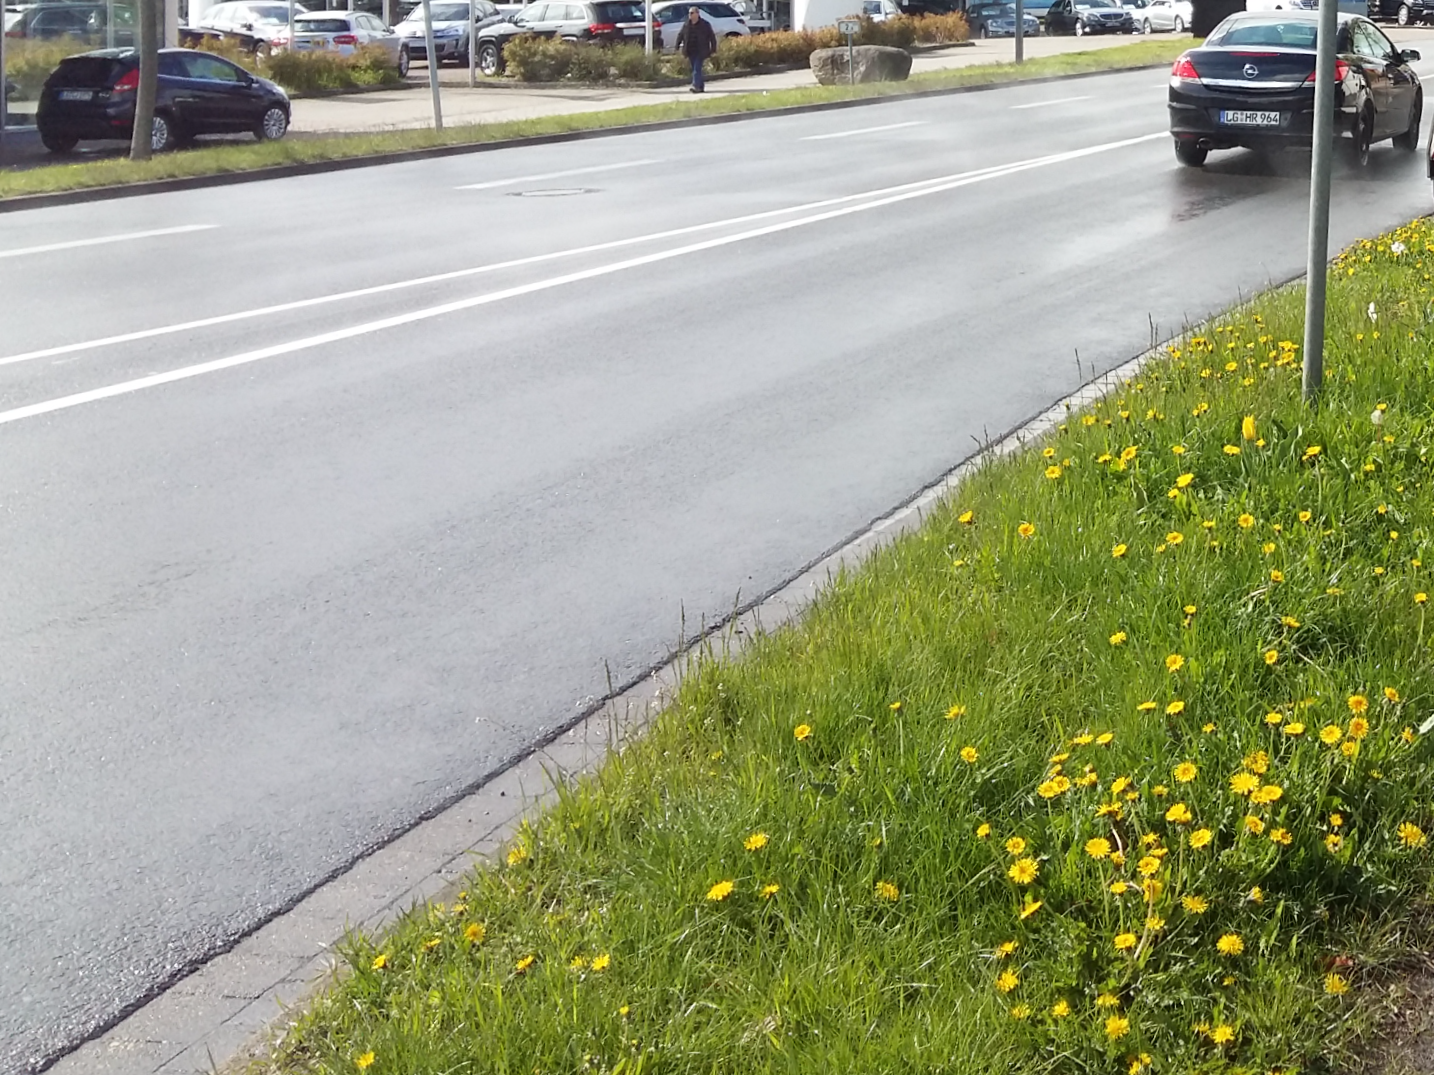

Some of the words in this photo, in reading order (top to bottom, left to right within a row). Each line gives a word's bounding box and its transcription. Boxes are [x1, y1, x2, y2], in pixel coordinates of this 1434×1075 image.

[1226, 111, 1239, 122] LG
[1245, 112, 1258, 123] HR
[1260, 113, 1278, 123] 964
